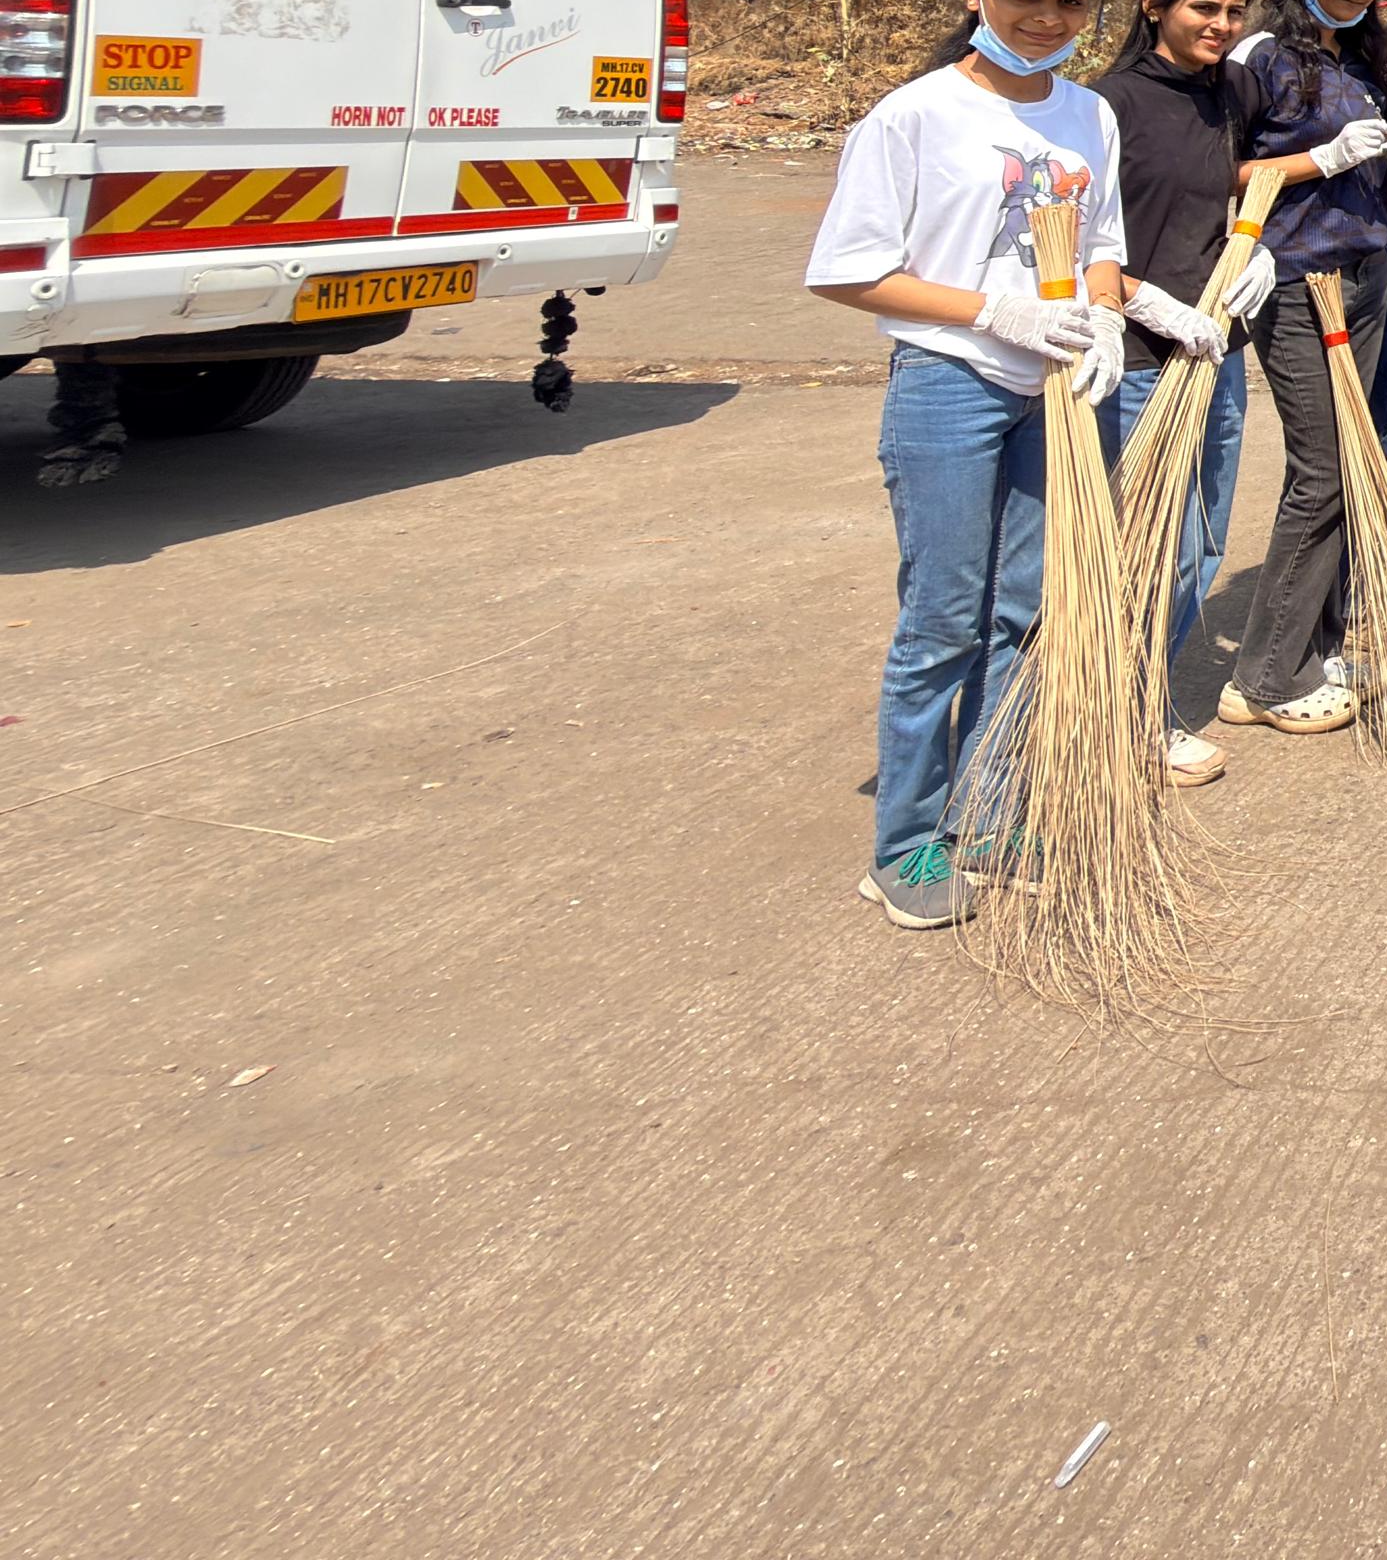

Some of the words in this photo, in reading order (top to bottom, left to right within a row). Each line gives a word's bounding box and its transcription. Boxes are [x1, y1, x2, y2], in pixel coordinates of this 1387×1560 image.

[480, 7, 583, 77] Janvi
[102, 43, 193, 71] STOP
[601, 62, 645, 75] MH.17.CV
[106, 75, 183, 92] SIGNAL
[594, 76, 649, 99] 2740
[94, 104, 226, 126] FORCE
[331, 106, 373, 127] HORN
[376, 106, 406, 127] NOT
[428, 107, 448, 127] OK
[450, 107, 501, 128] PLEASE
[602, 119, 643, 128] SUPER
[316, 270, 474, 311] MH17CV2740
